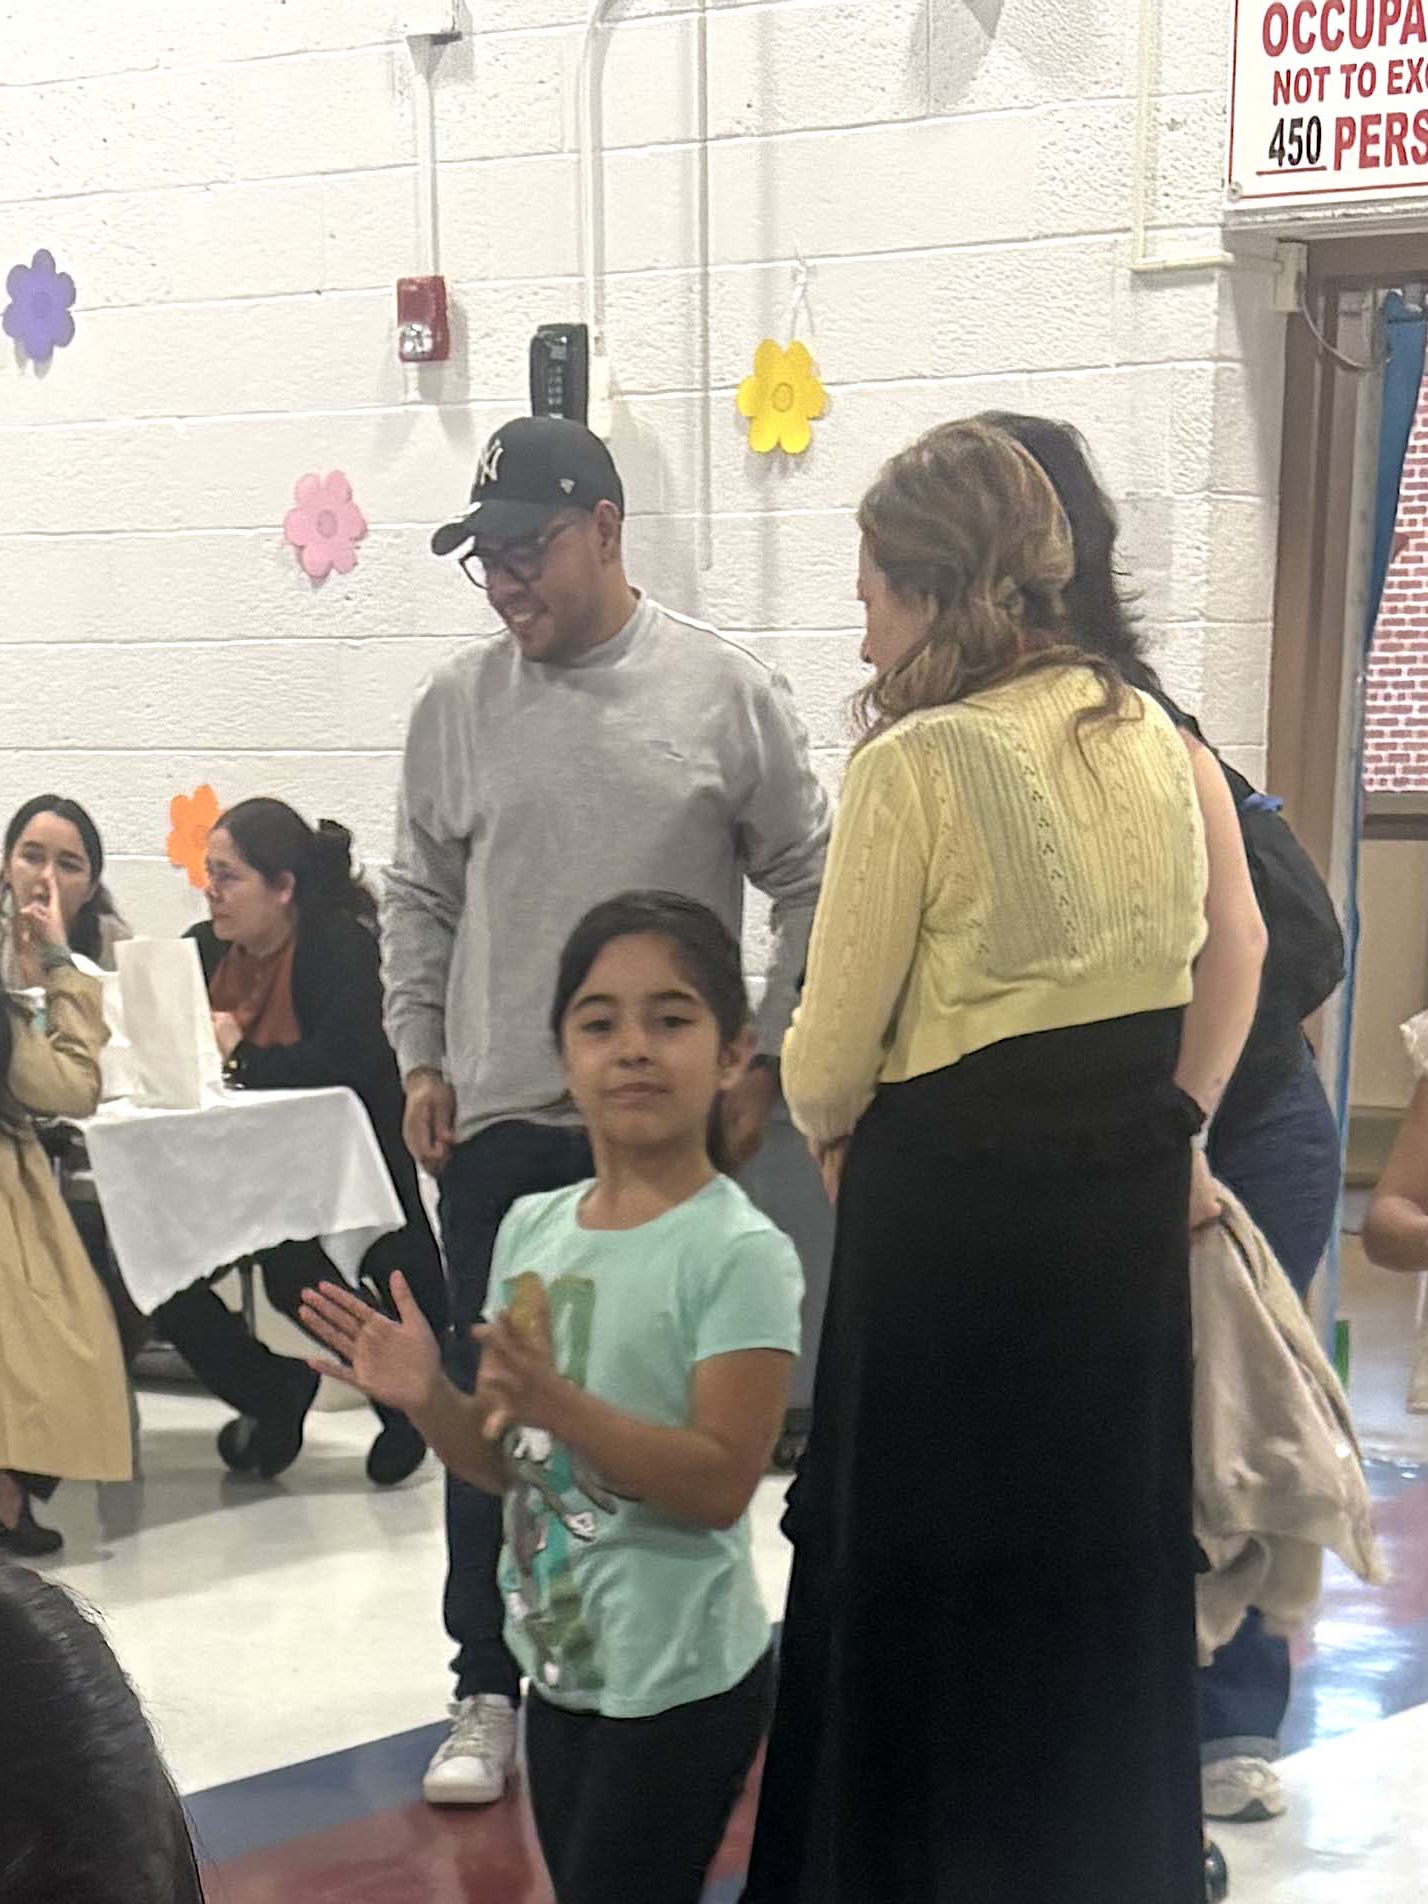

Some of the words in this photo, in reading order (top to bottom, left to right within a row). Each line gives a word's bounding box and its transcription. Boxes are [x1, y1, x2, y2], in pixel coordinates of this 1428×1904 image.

[1272, 66, 1331, 106] NOT
[1340, 61, 1377, 99] TO
[1268, 115, 1323, 168] 450
